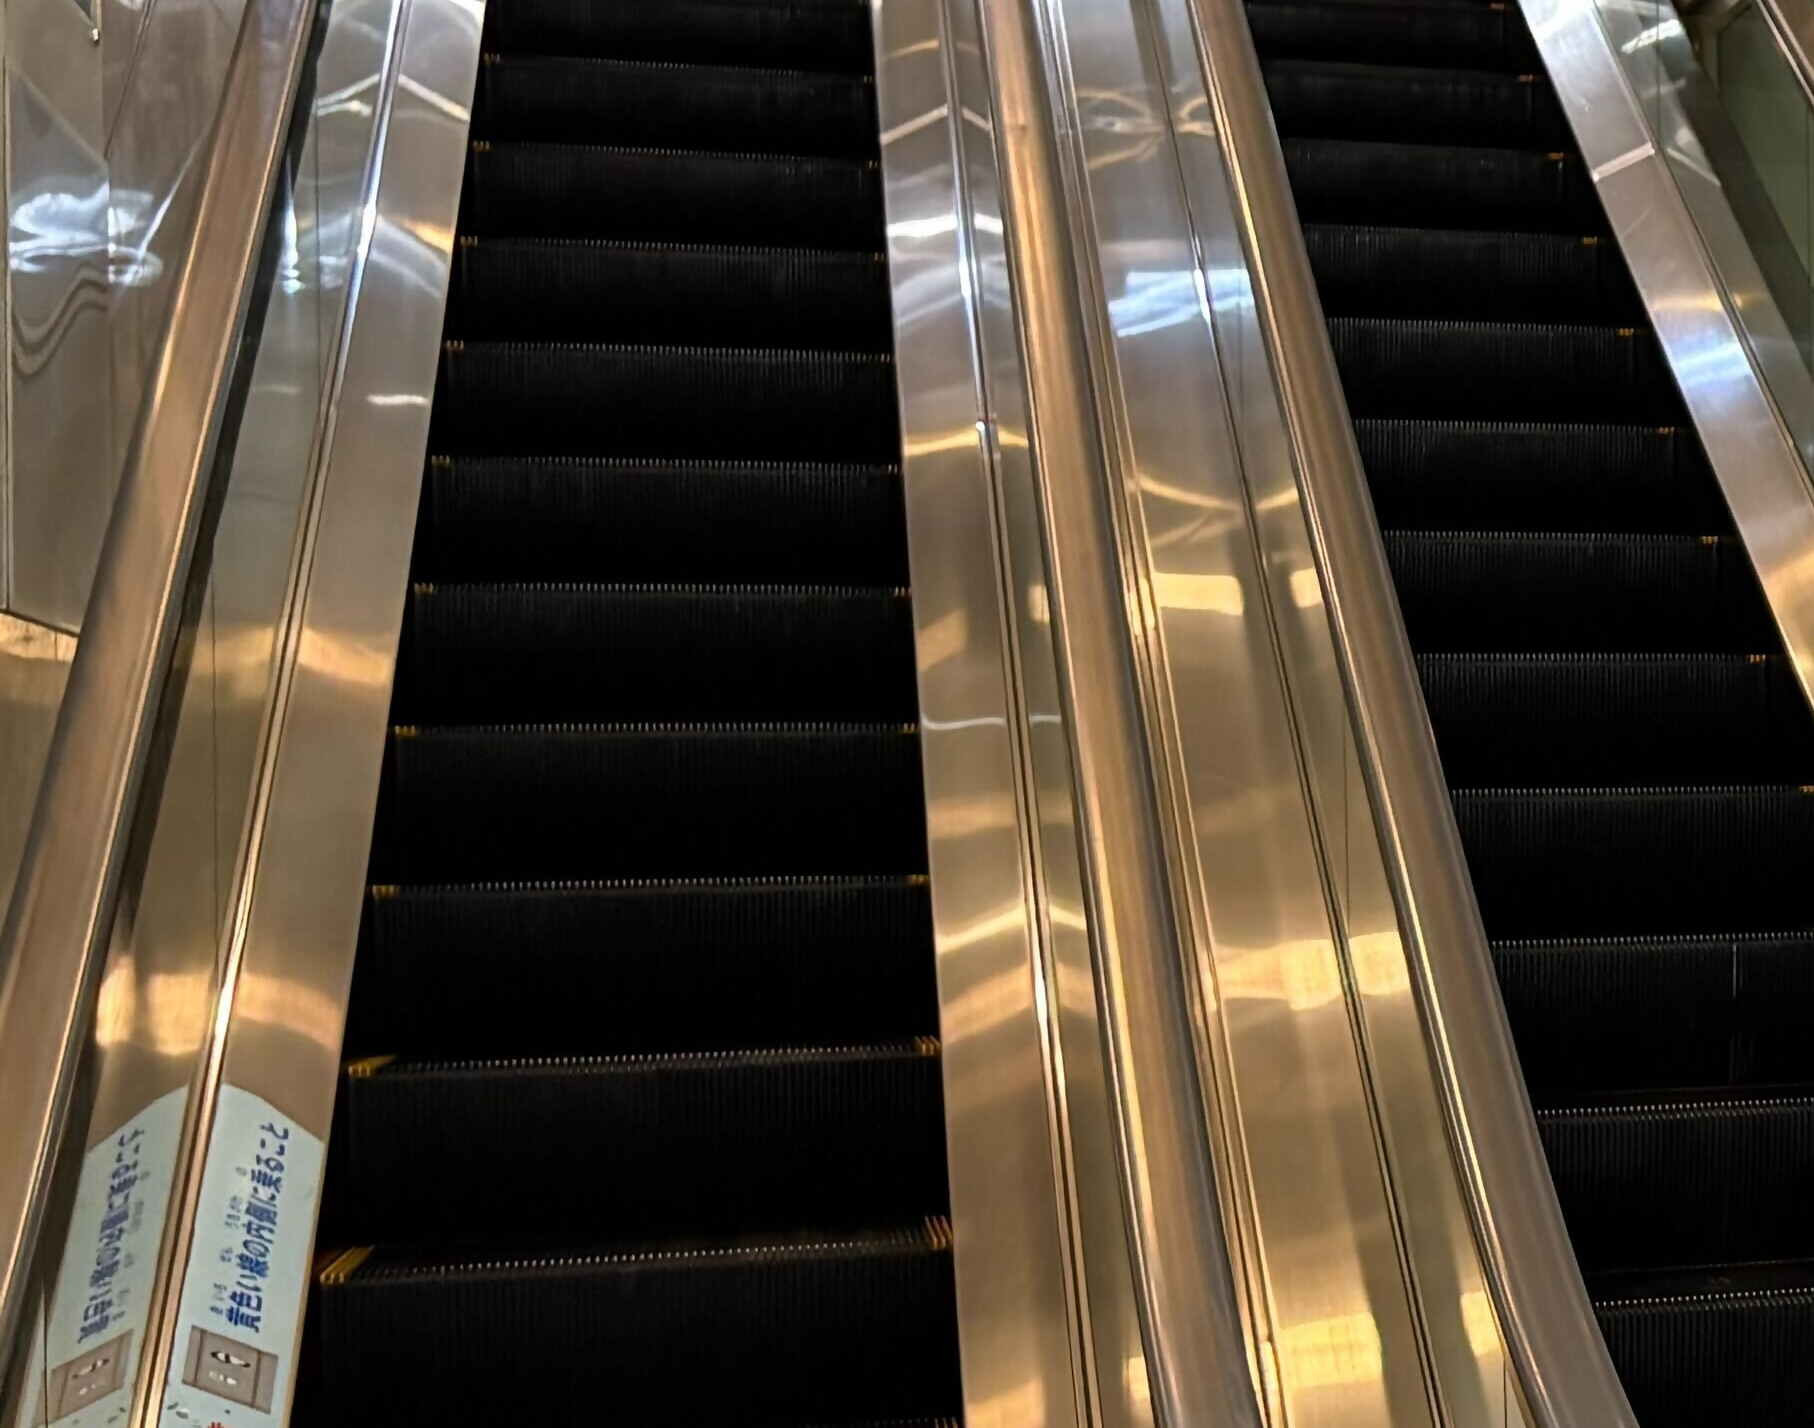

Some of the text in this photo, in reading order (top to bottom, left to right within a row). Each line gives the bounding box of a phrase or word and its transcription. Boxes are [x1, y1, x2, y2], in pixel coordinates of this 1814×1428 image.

[225, 1121, 290, 1334] 黄色い線の内側に乗ること
